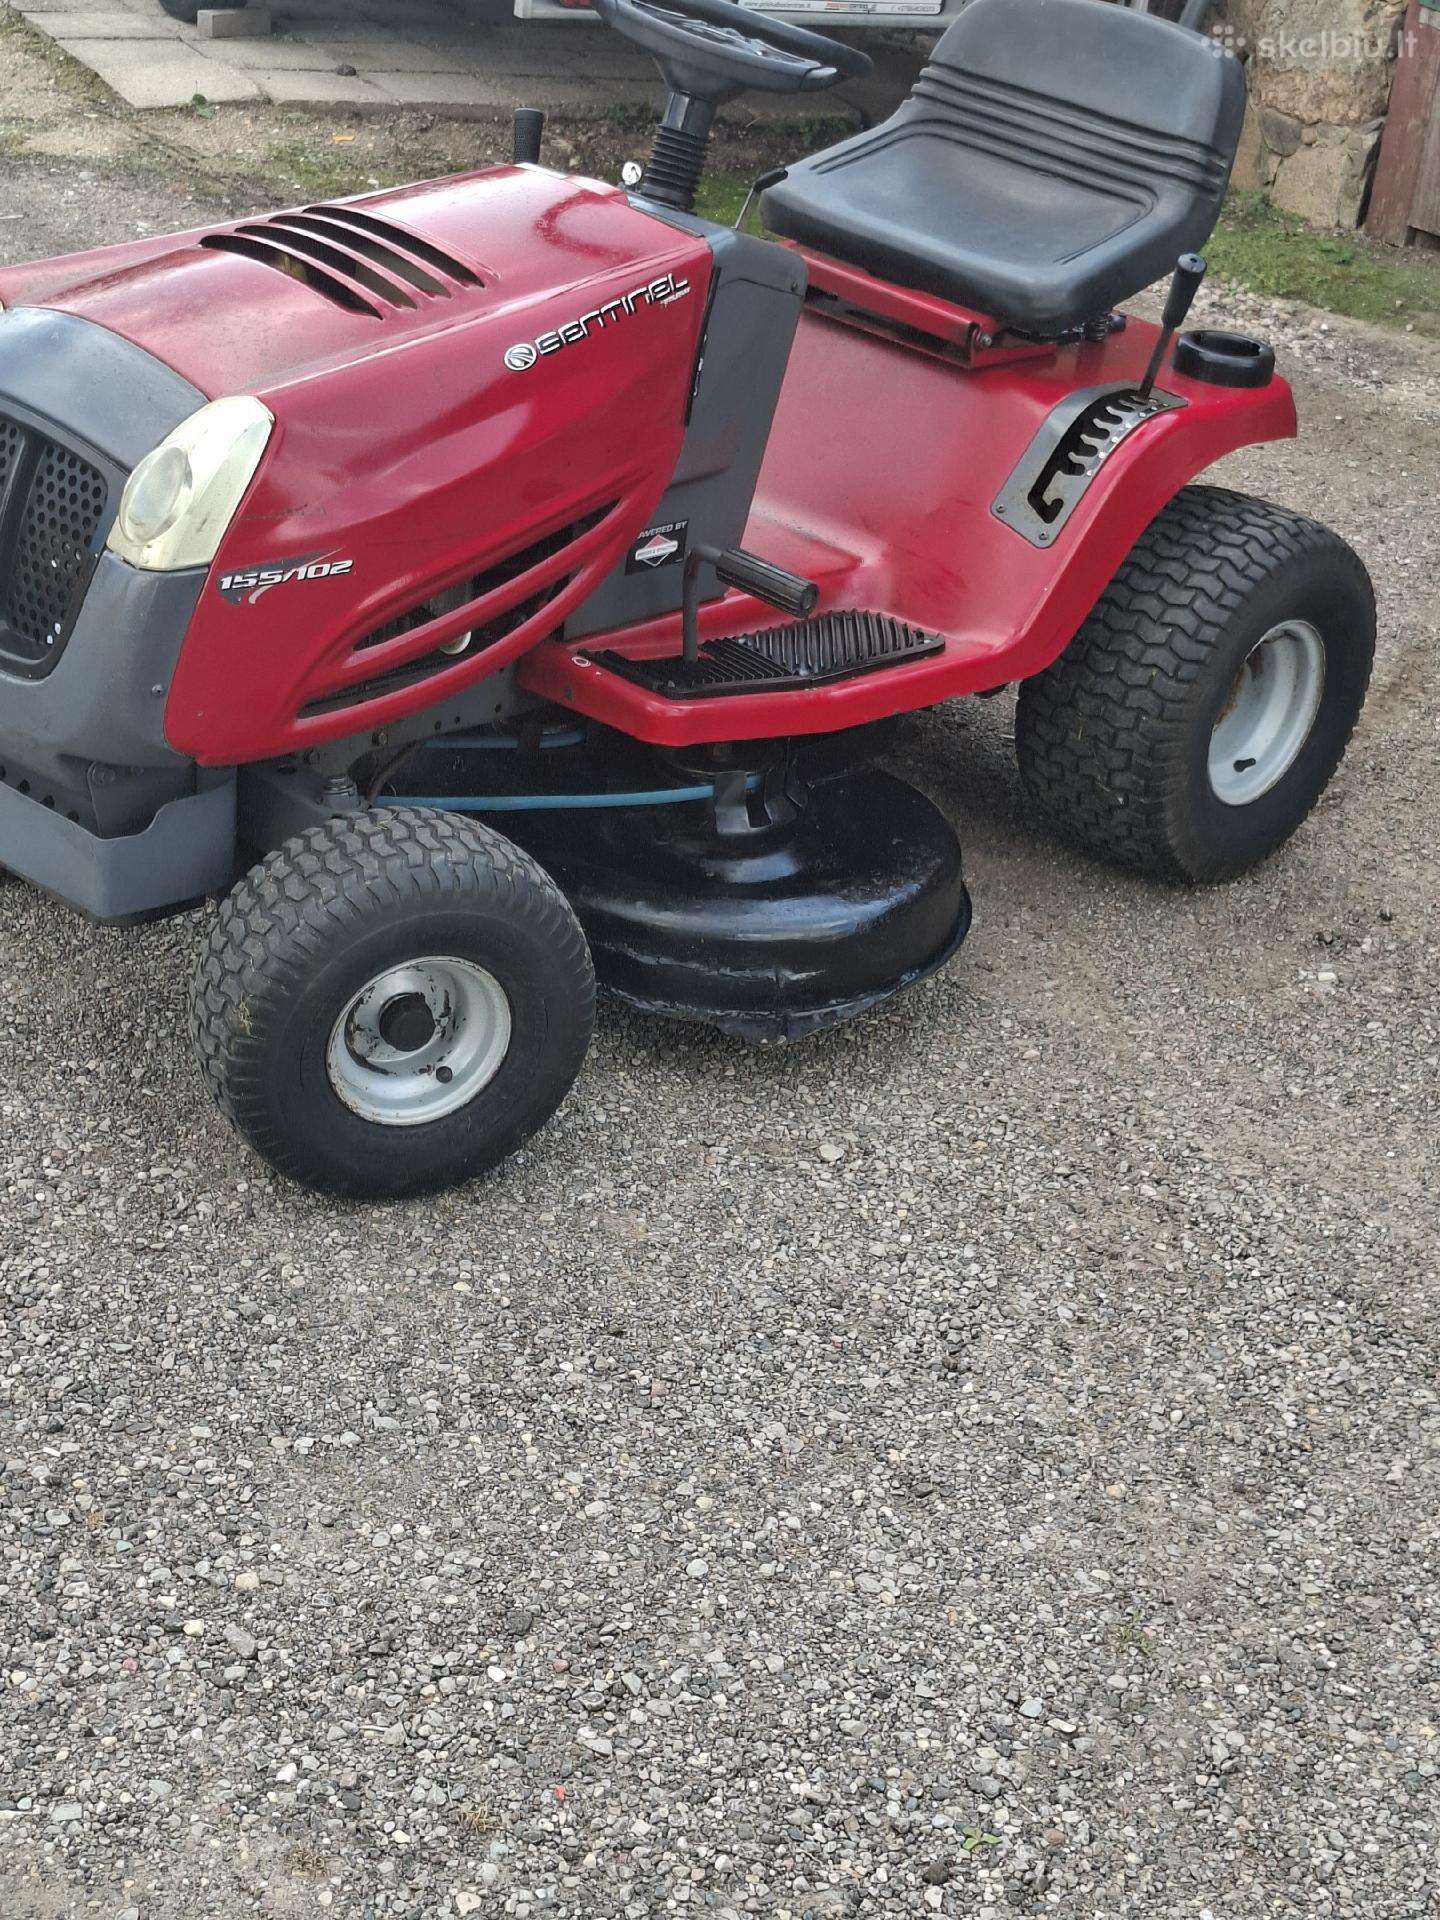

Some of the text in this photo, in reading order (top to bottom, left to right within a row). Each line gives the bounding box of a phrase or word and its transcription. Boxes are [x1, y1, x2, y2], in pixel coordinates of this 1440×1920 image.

[534, 273, 689, 356] SENTINEL
[675, 520, 688, 531] BY
[220, 559, 354, 590] 155/102
